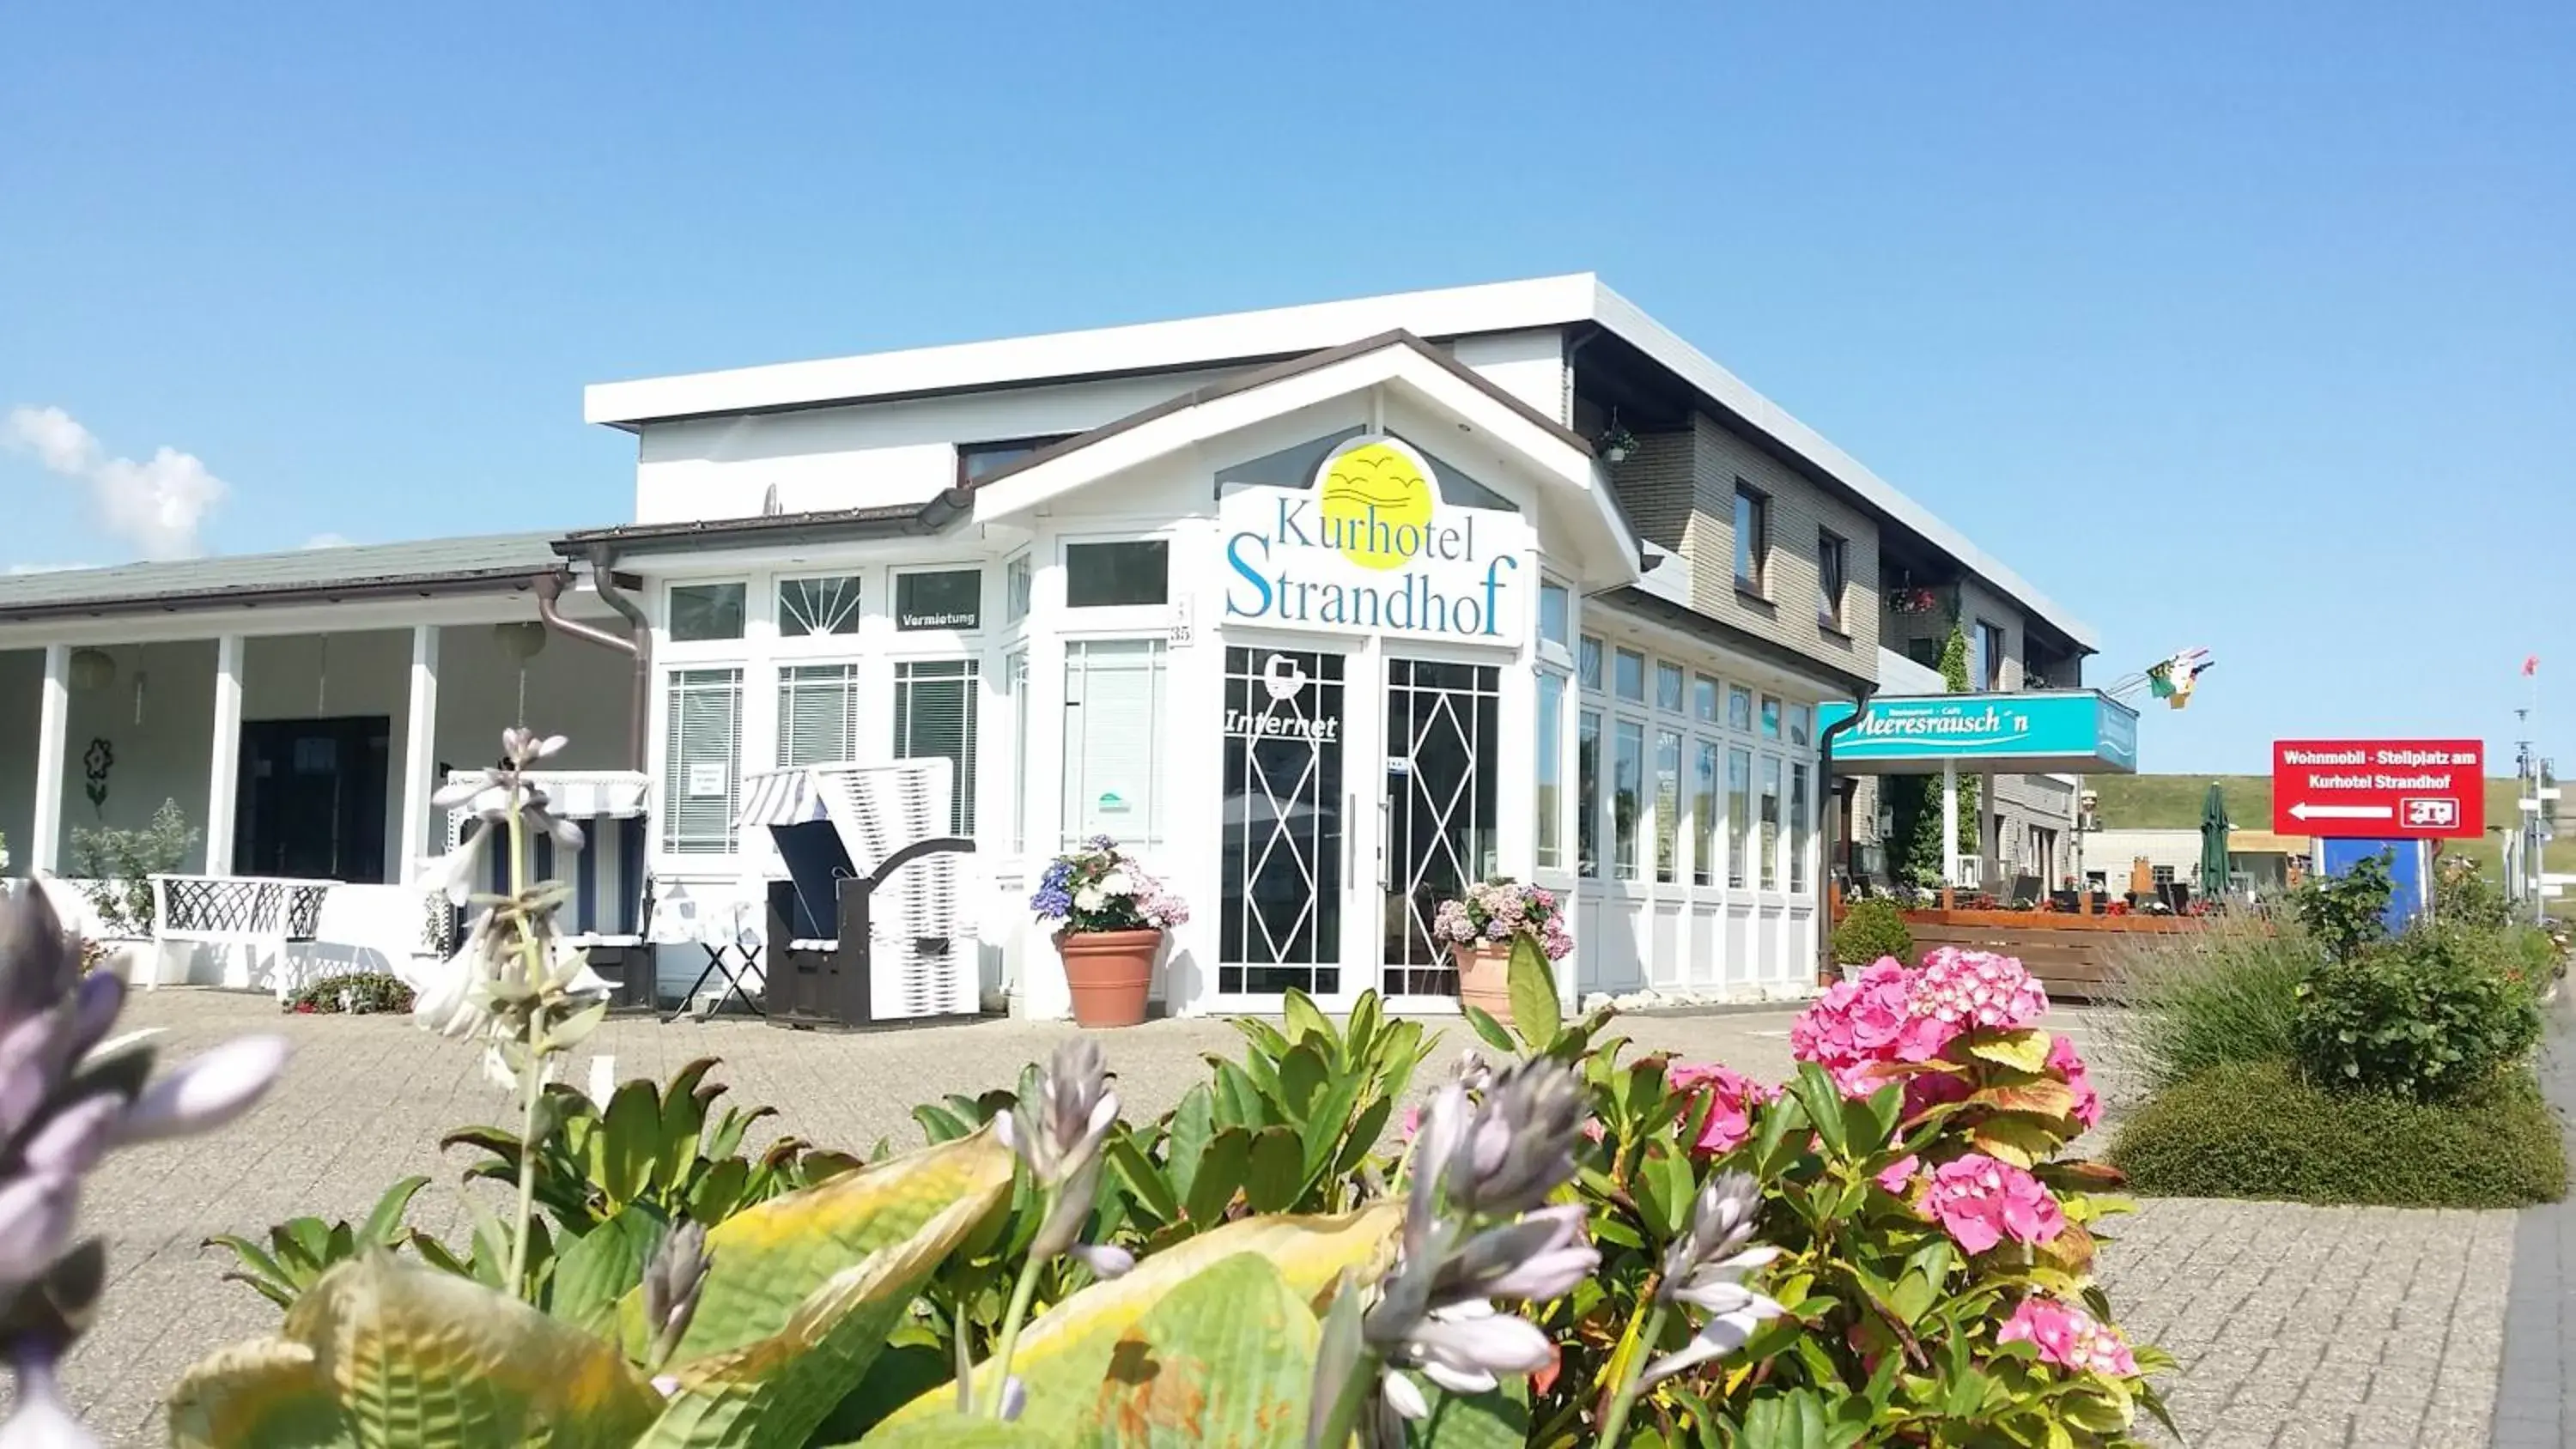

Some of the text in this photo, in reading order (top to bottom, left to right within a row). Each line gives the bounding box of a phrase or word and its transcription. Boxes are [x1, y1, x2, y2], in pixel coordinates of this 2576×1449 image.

[1278, 498, 1474, 562] Kurhotel
[1225, 532, 1518, 637] Strandhof
[902, 612, 975, 626] Vermietung
[1170, 626, 1190, 641] 35
[1224, 709, 1339, 739] Internet
[2283, 750, 2366, 765] Wohnmobil
[2377, 750, 2449, 767] Stellplatz
[2451, 754, 2476, 765] am
[2309, 774, 2452, 789] Kurhotel Strandhof
